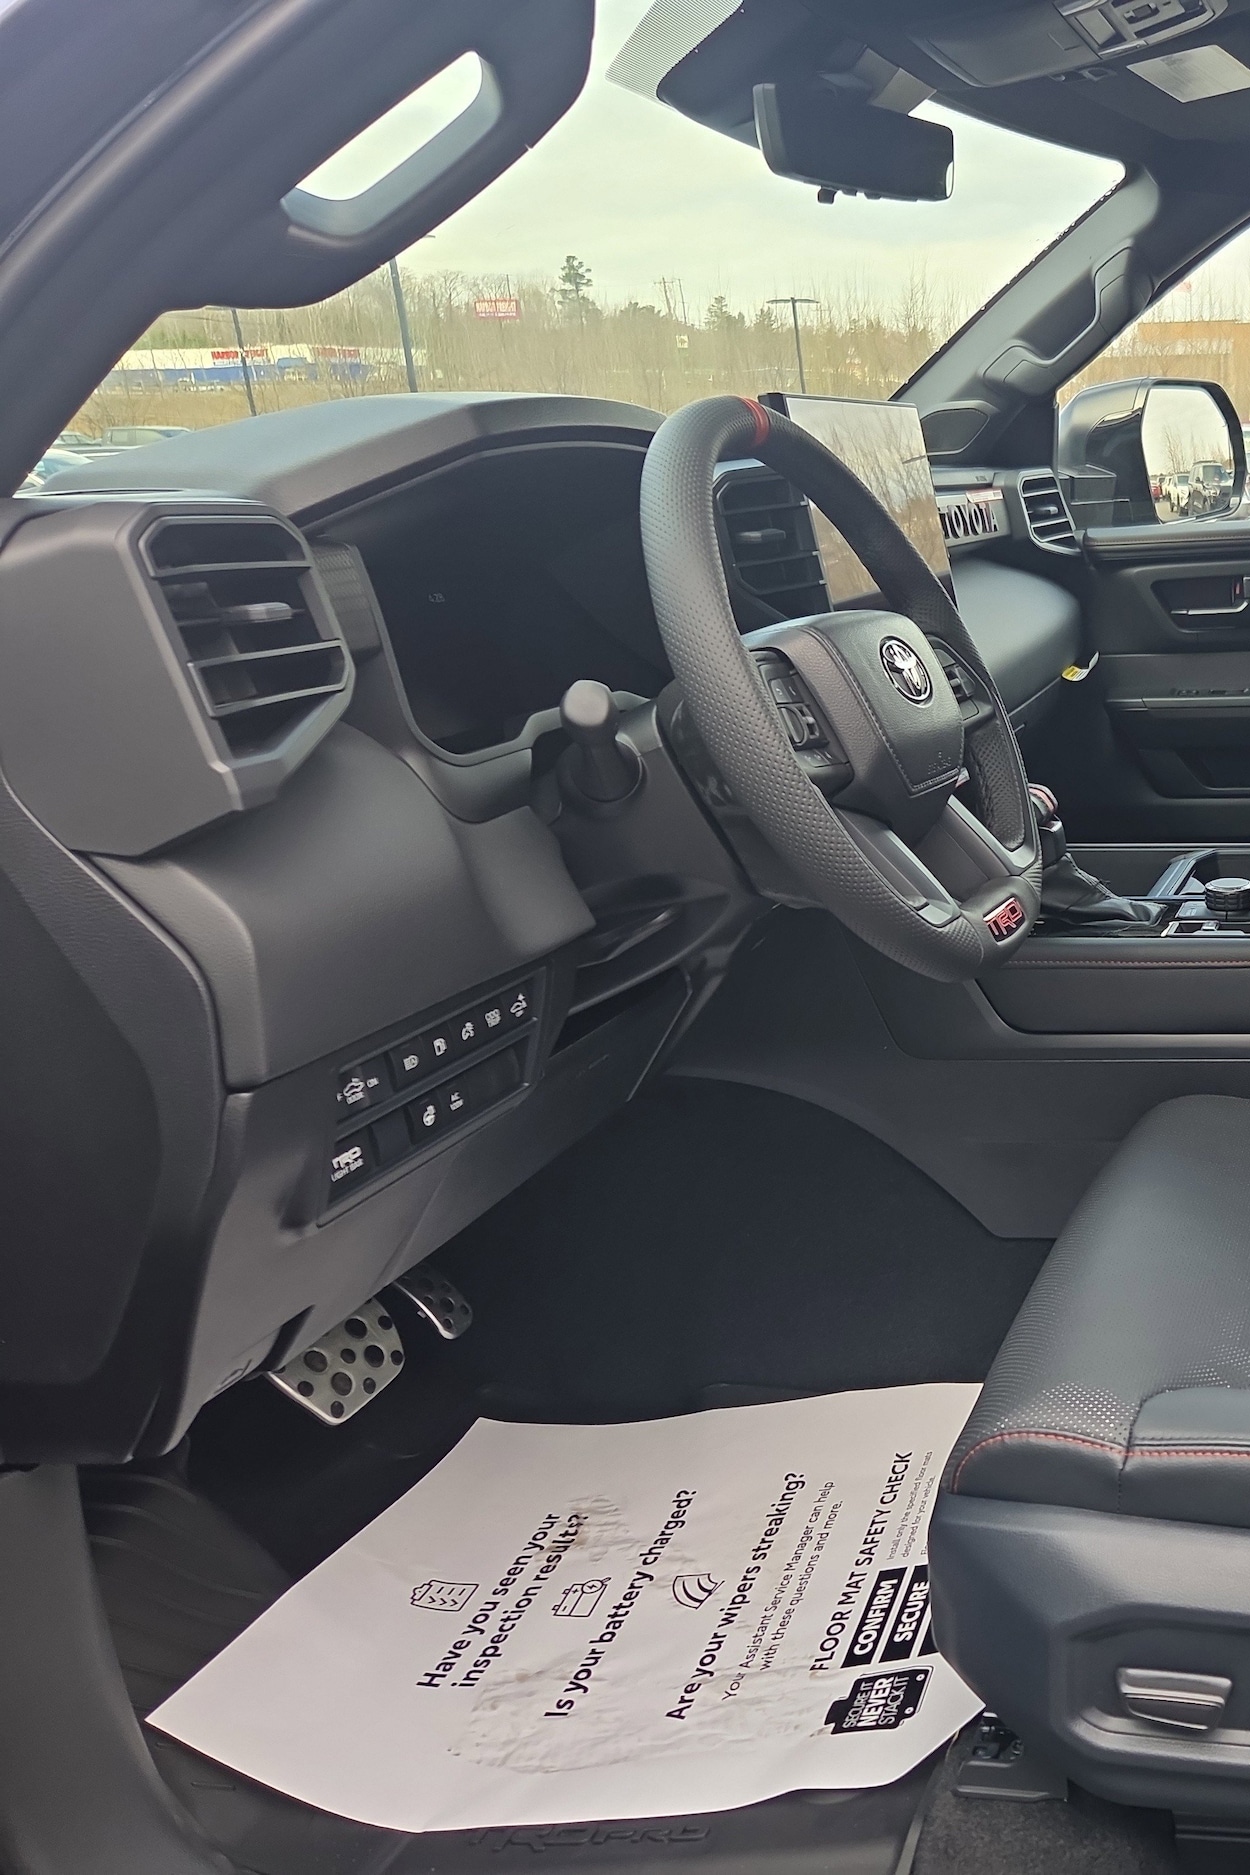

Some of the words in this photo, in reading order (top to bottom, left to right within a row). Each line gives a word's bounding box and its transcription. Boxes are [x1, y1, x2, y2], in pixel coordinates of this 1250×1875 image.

[939, 502, 1000, 539] TOYOTA
[986, 898, 1023, 936] TRD
[808, 1505, 823, 1523] can
[813, 1481, 835, 1503] help
[907, 1482, 921, 1511] specified
[896, 1522, 908, 1538] only
[901, 1511, 911, 1523] the
[784, 1525, 814, 1571] Manager
[809, 1609, 852, 1671] FLOOR
[838, 1571, 868, 1606] MAT
[855, 1509, 892, 1567] SAFETY
[880, 1451, 913, 1505] CHECK
[887, 1539, 901, 1560] Install
[902, 1526, 918, 1558] designed
[416, 1639, 471, 1687] Have
[461, 1602, 500, 1635] you
[492, 1555, 533, 1596] seen
[523, 1514, 560, 1551] your
[451, 1586, 542, 1687] inspection
[532, 1514, 589, 1581] results?
[544, 1699, 575, 1717] Is
[563, 1649, 605, 1693] your
[588, 1571, 654, 1644] battery
[639, 1489, 697, 1566] charged?
[665, 1682, 702, 1720] Are
[691, 1632, 727, 1678] your
[717, 1565, 762, 1628] wipers
[751, 1473, 806, 1561] streaking?
[759, 1643, 780, 1671] with
[771, 1608, 795, 1642] these
[789, 1554, 820, 1607] questions
[814, 1532, 830, 1552] and
[824, 1500, 843, 1529] more.
[764, 1574, 793, 1612] Service
[853, 1578, 899, 1656] CONFIRM
[893, 1581, 930, 1643] SECURE
[739, 1614, 774, 1669] Assistant
[721, 1672, 746, 1701] Your
[842, 1690, 871, 1728] SECURE
[860, 1681, 873, 1691] IT
[857, 1676, 894, 1727] NEVER
[878, 1686, 907, 1725] STACK
[893, 1676, 909, 1687] IT
